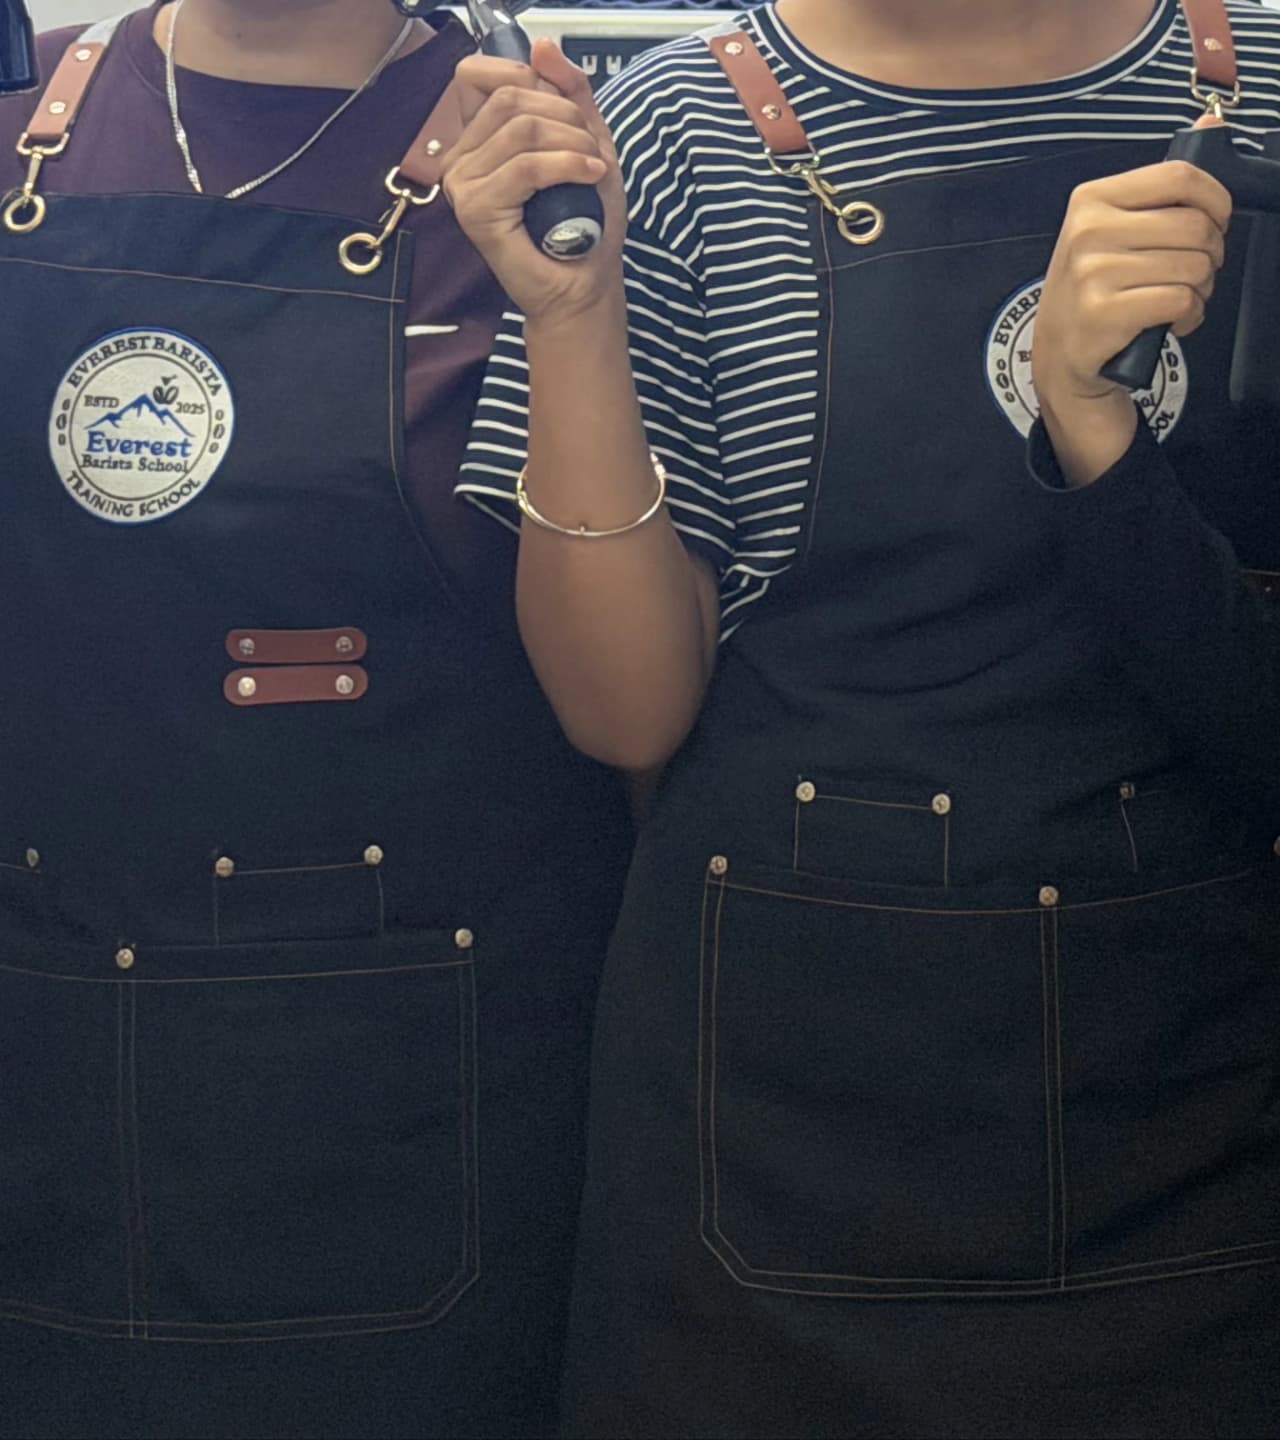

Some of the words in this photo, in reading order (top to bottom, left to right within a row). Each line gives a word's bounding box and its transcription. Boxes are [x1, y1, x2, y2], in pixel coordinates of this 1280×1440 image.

[67, 336, 151, 389] EVEREST
[152, 336, 223, 397] BARISTA
[82, 453, 133, 470] Barista
[138, 457, 189, 473] School
[86, 430, 193, 458] Everest
[66, 470, 134, 518] TRAINING
[139, 478, 201, 517] SCHOOL
